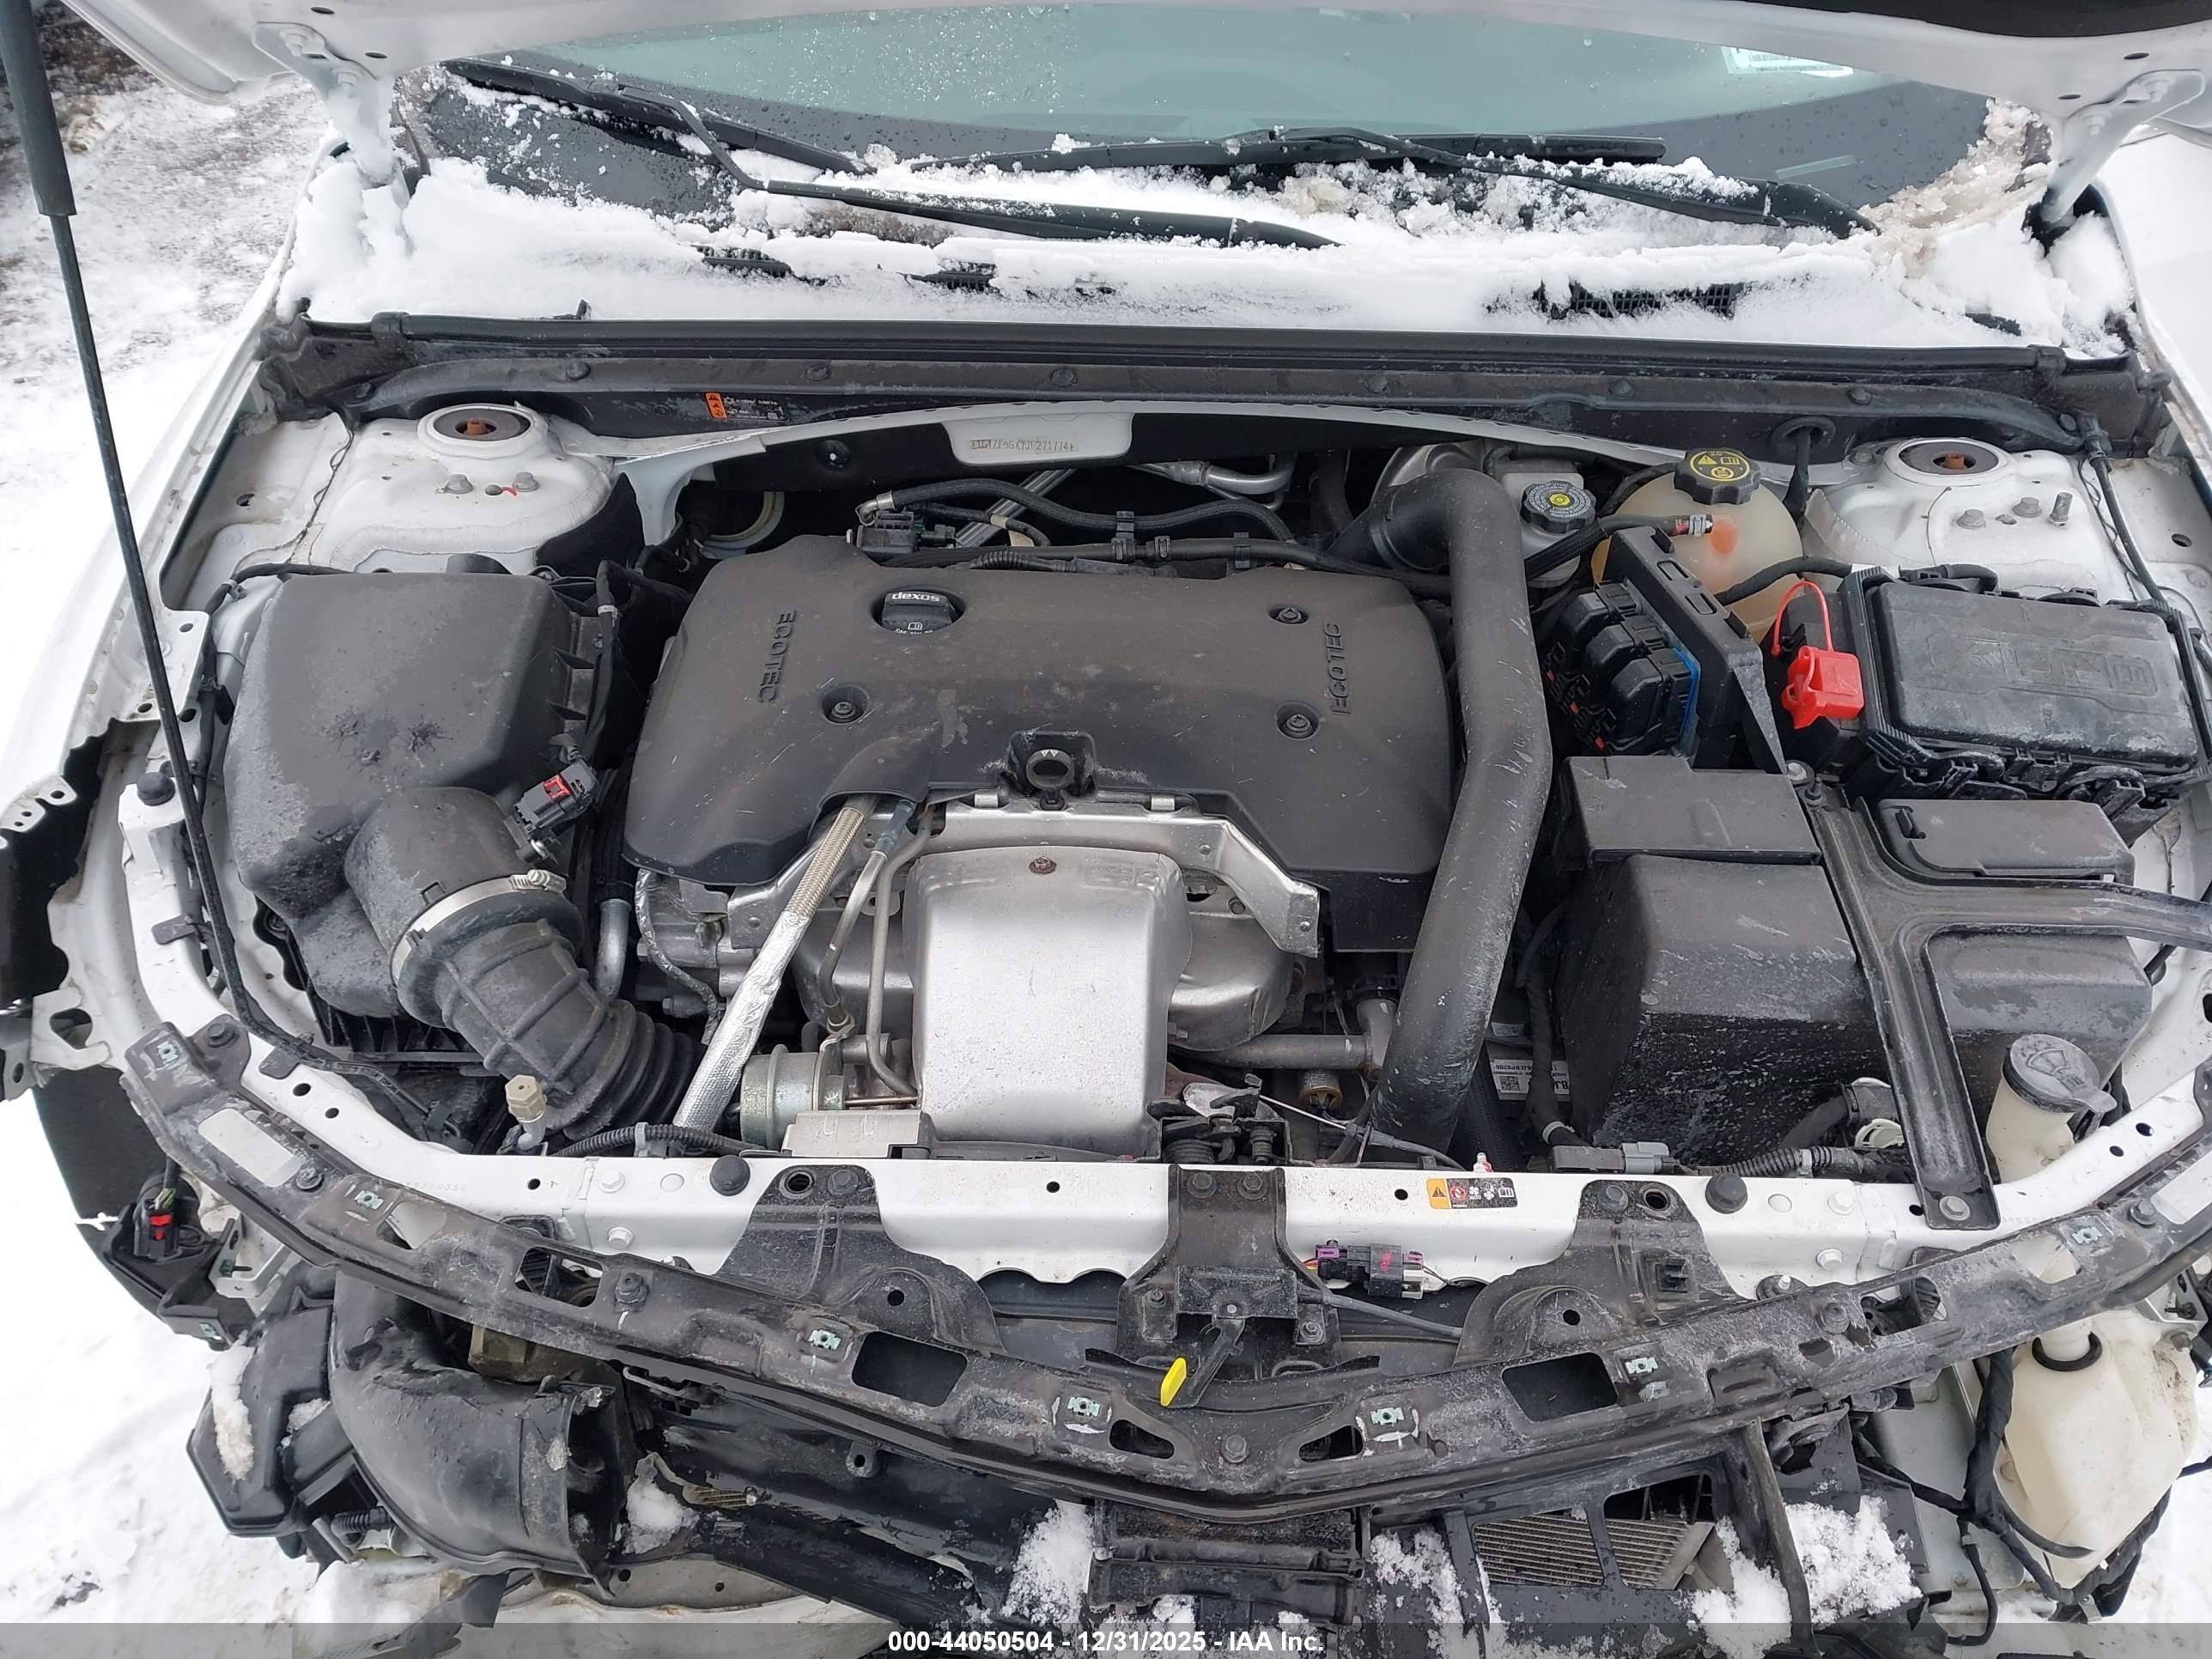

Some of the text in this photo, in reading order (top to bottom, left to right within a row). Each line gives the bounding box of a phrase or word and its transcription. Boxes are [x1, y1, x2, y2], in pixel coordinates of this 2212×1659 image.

[891, 592, 939, 602] dexos
[758, 609, 797, 702] ECOTEC
[1324, 623, 1352, 714] ECOTEC
